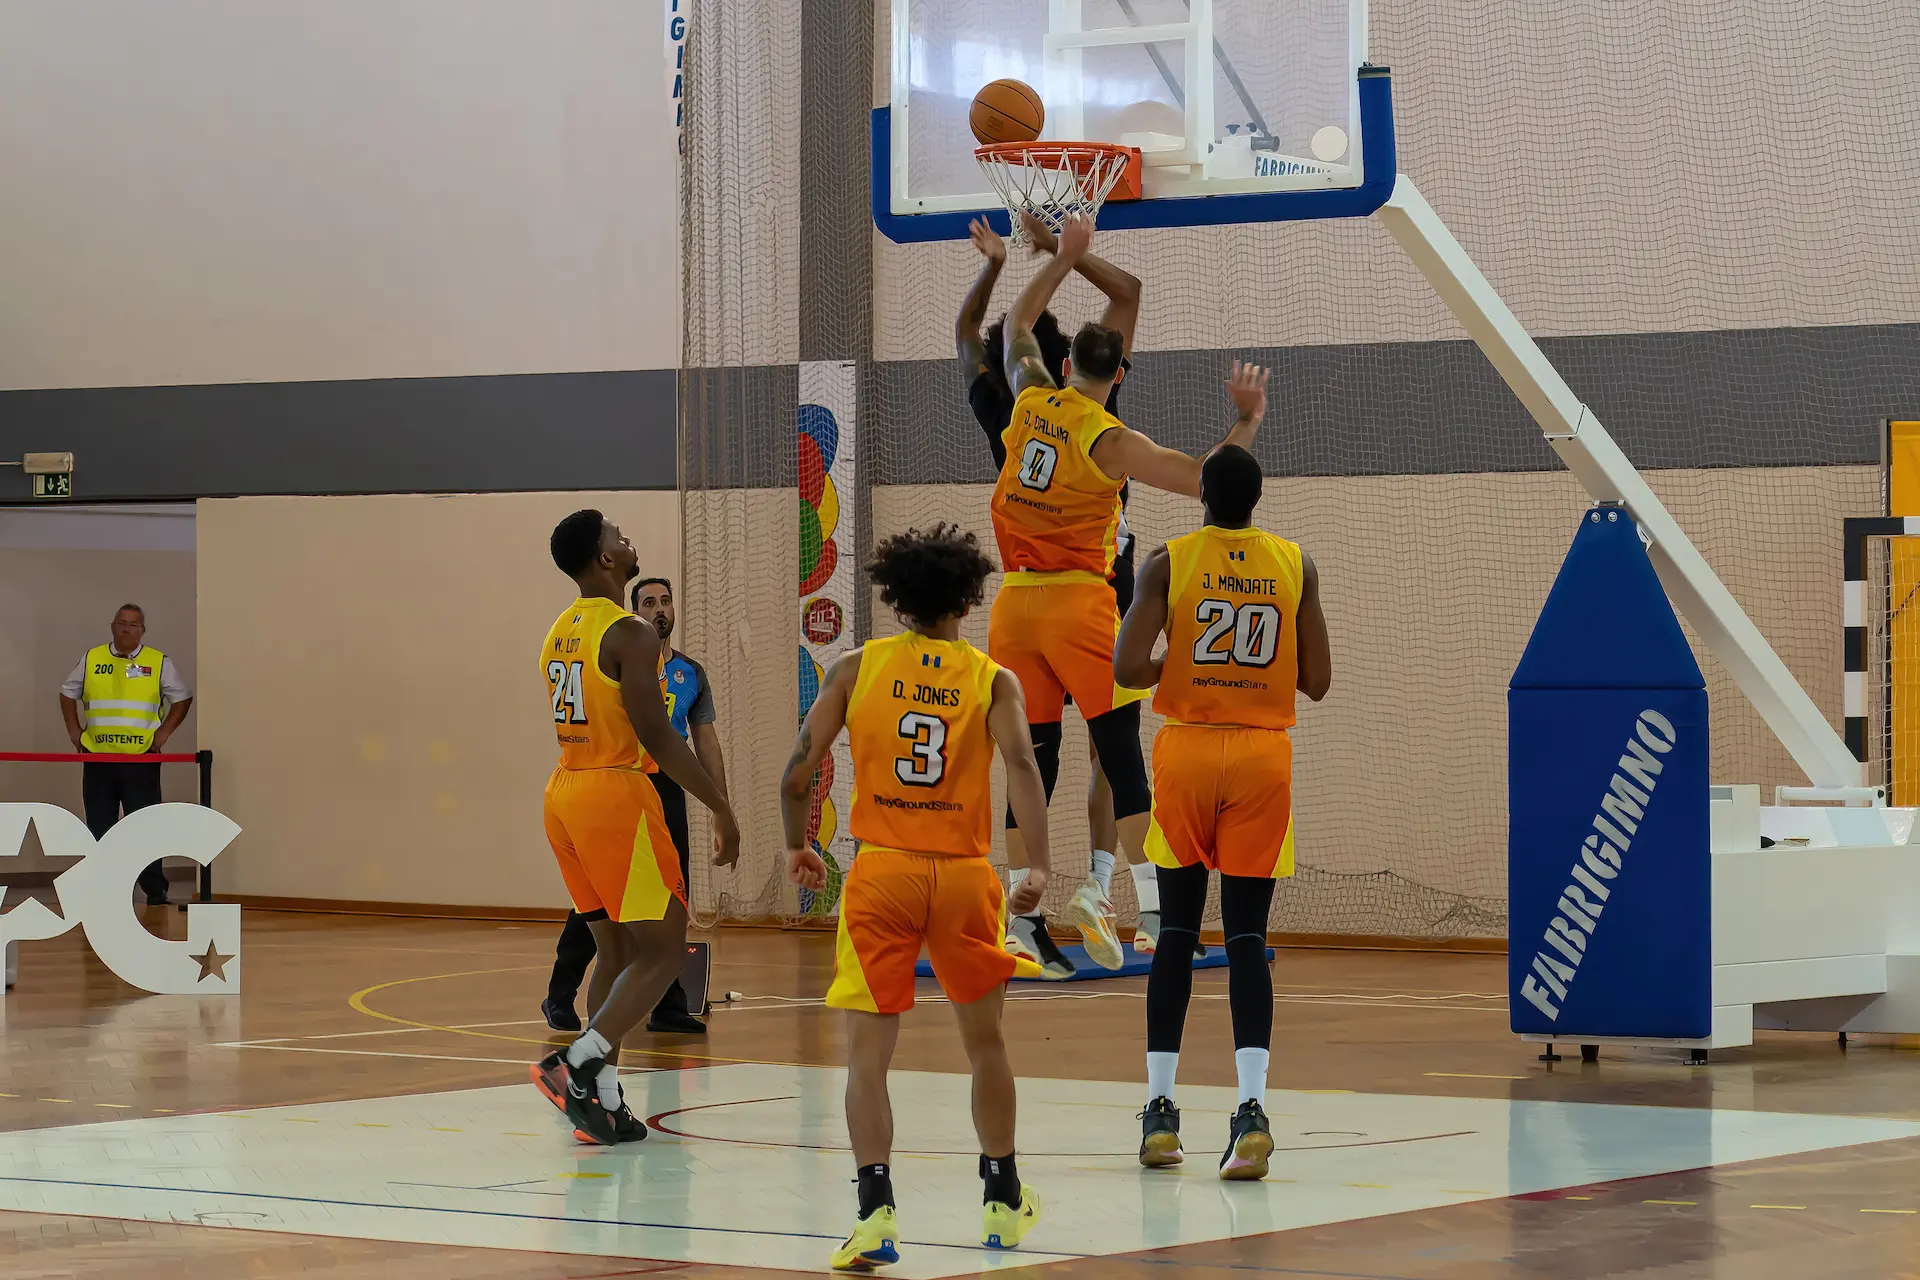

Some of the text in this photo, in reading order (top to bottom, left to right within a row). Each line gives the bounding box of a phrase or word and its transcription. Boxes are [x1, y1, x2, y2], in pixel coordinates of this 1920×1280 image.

[1018, 437, 1058, 493] 0
[1203, 573, 1277, 596] J. MANJATE
[1192, 597, 1283, 669] 20
[94, 664, 114, 674] 200
[547, 660, 589, 724] 24
[892, 679, 960, 707] D. JONES
[893, 710, 949, 788] 3
[1520, 708, 1677, 1022] FABRIGIMNO
